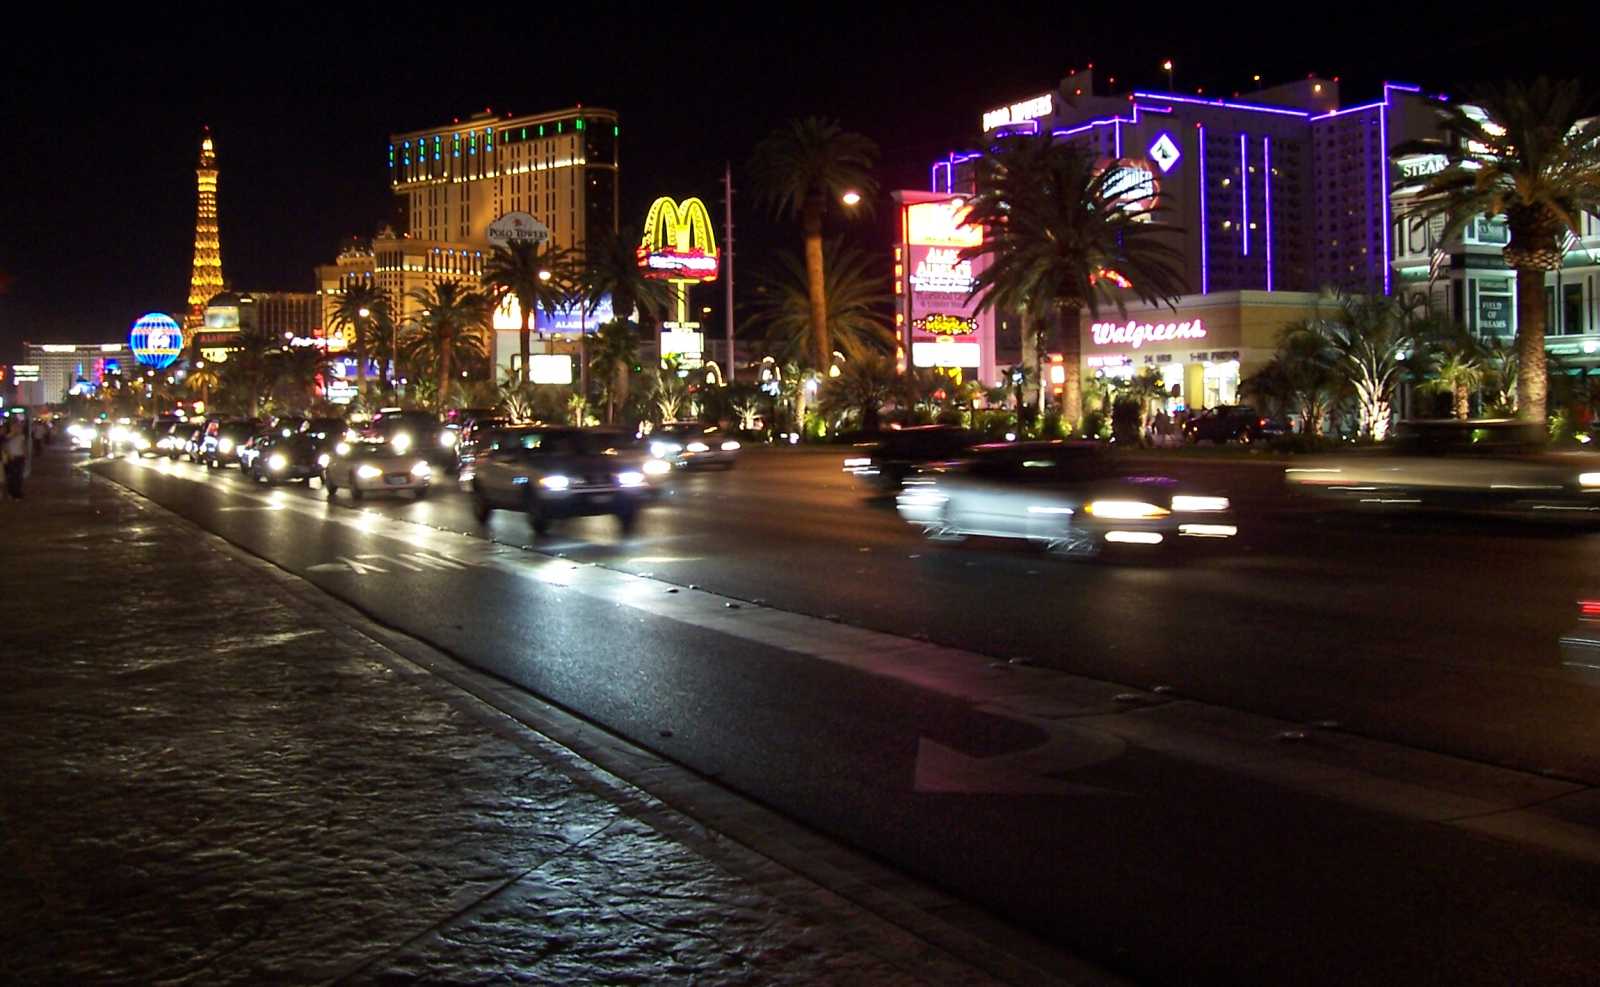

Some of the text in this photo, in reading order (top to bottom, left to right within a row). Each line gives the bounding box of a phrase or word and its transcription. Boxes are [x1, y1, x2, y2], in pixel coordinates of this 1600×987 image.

[489, 228, 548, 240] POLO TOWERS
[1482, 302, 1503, 310] FIELD
[1488, 312, 1497, 320] OF
[1091, 319, 1206, 349] Walgreens
